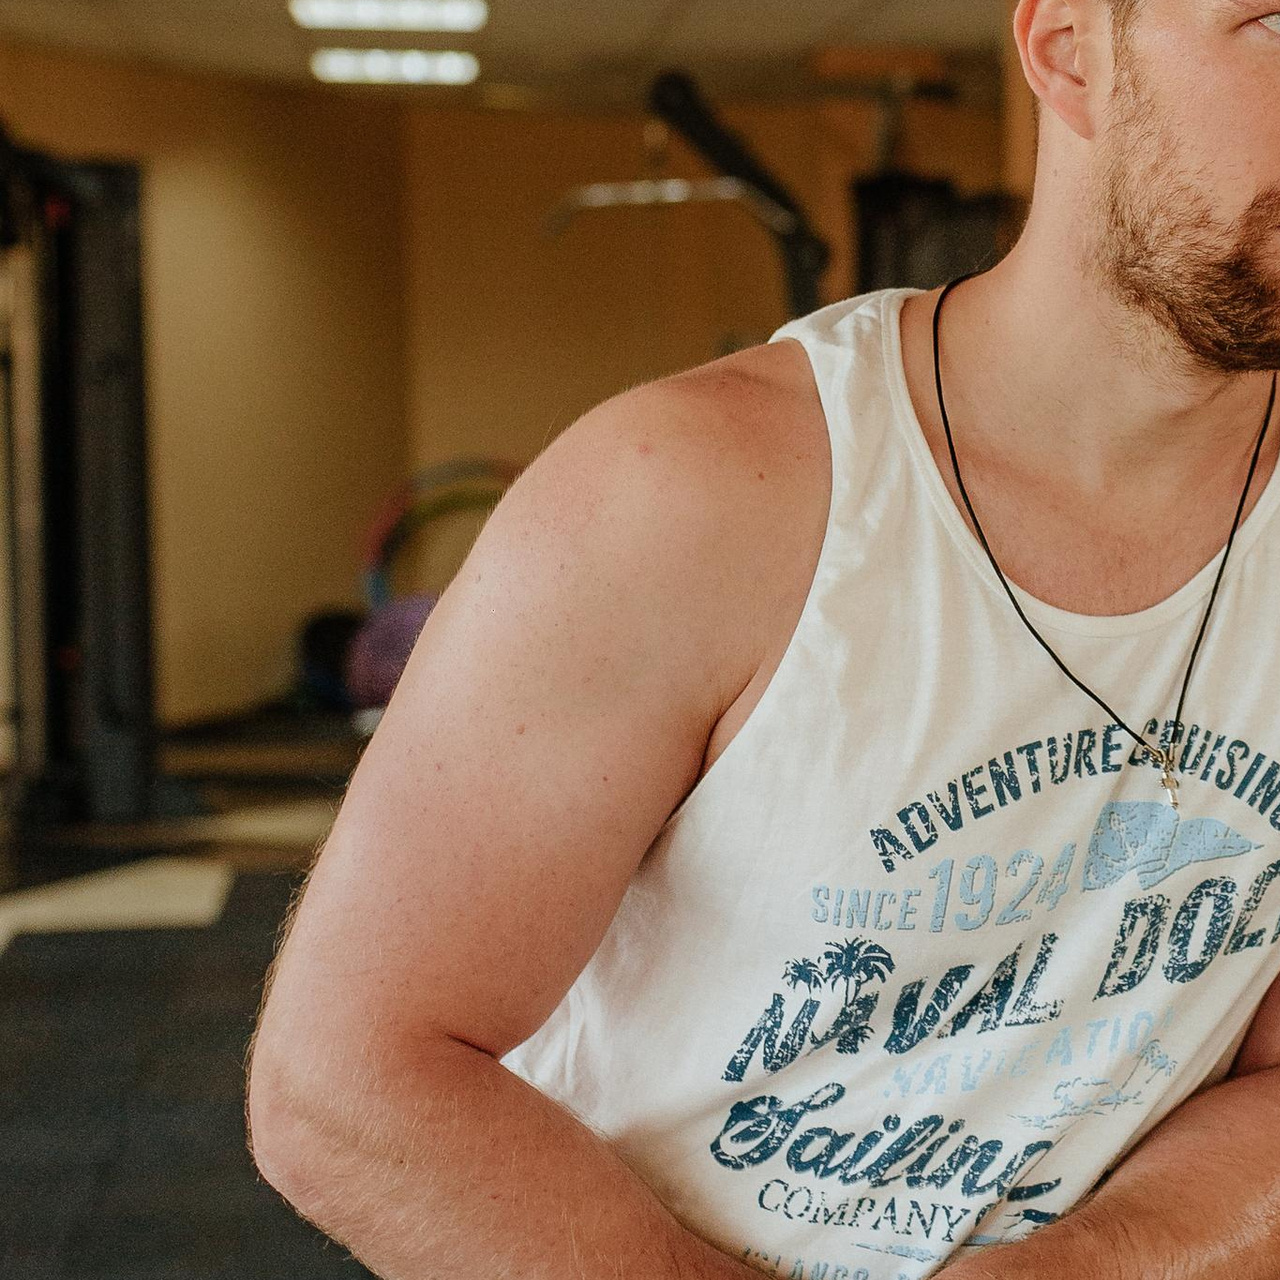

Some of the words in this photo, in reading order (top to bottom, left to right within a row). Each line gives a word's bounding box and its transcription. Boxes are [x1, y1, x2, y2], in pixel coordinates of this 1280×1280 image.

[870, 723, 1123, 873] ADVENTURE
[811, 885, 921, 931] SINCE
[927, 840, 1077, 933] 1924
[884, 1006, 1175, 1098] NAVIGATIO
[758, 1179, 970, 1243] COMPANY
